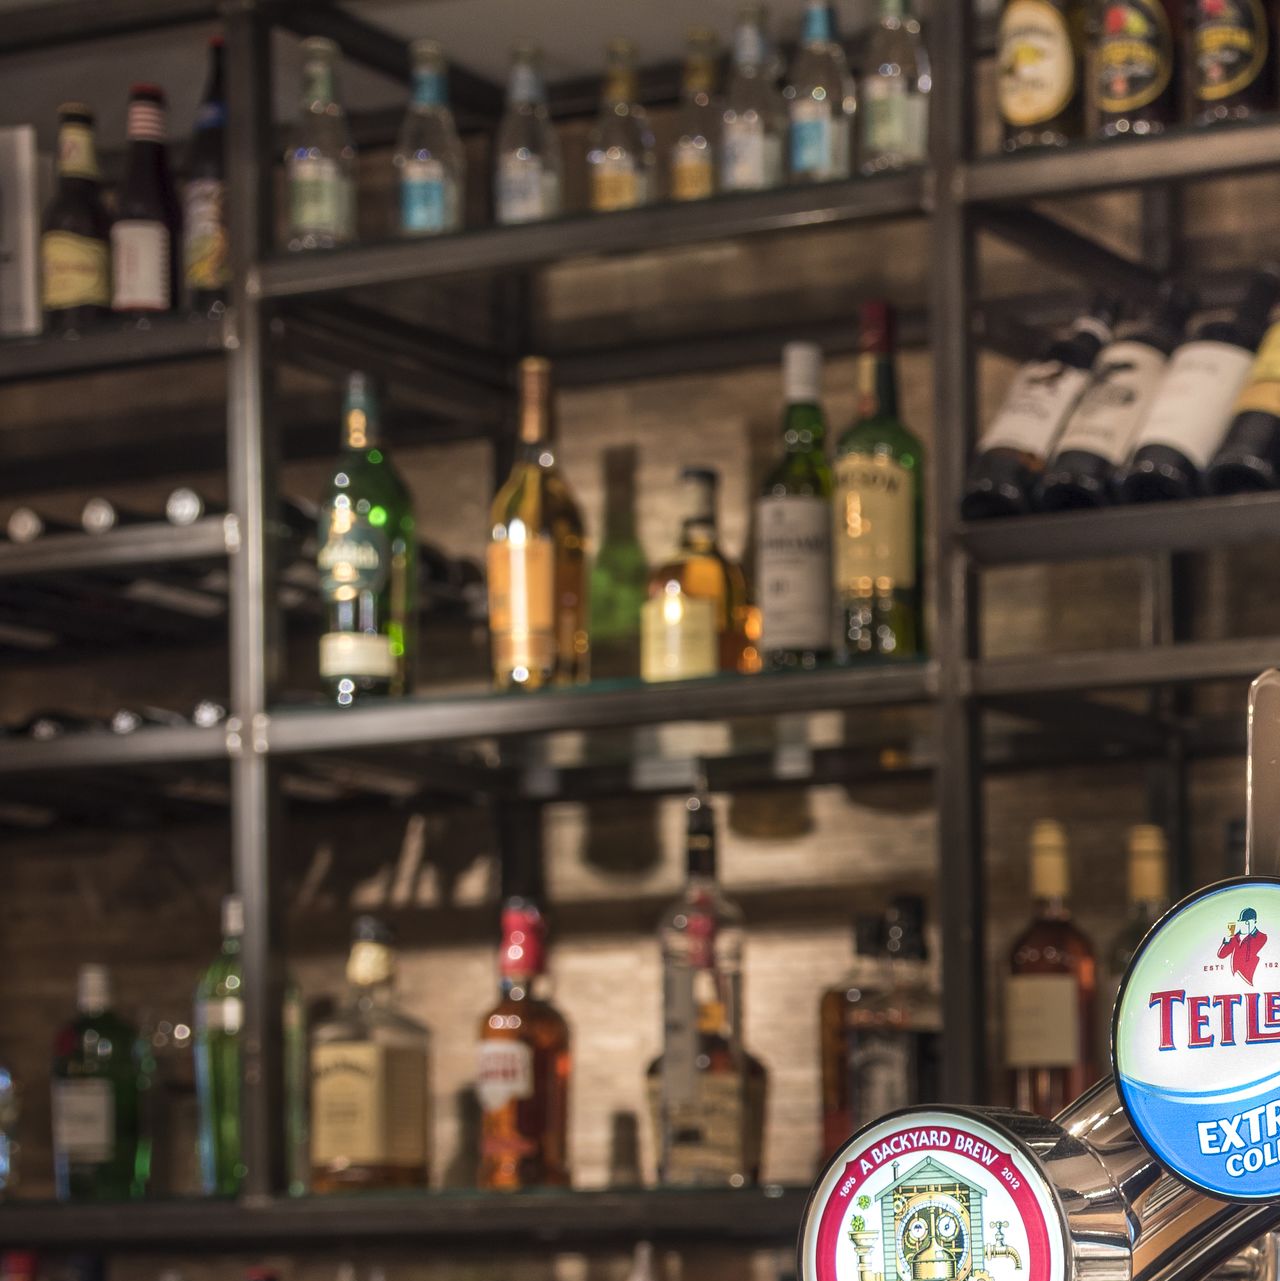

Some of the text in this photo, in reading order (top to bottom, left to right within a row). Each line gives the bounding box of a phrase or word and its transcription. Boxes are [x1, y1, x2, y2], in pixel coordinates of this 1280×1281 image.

[860, 1130, 999, 1175] A BACKYARD BREW
[839, 1176, 857, 1198] 1896
[1000, 1167, 1020, 1190] 2012
